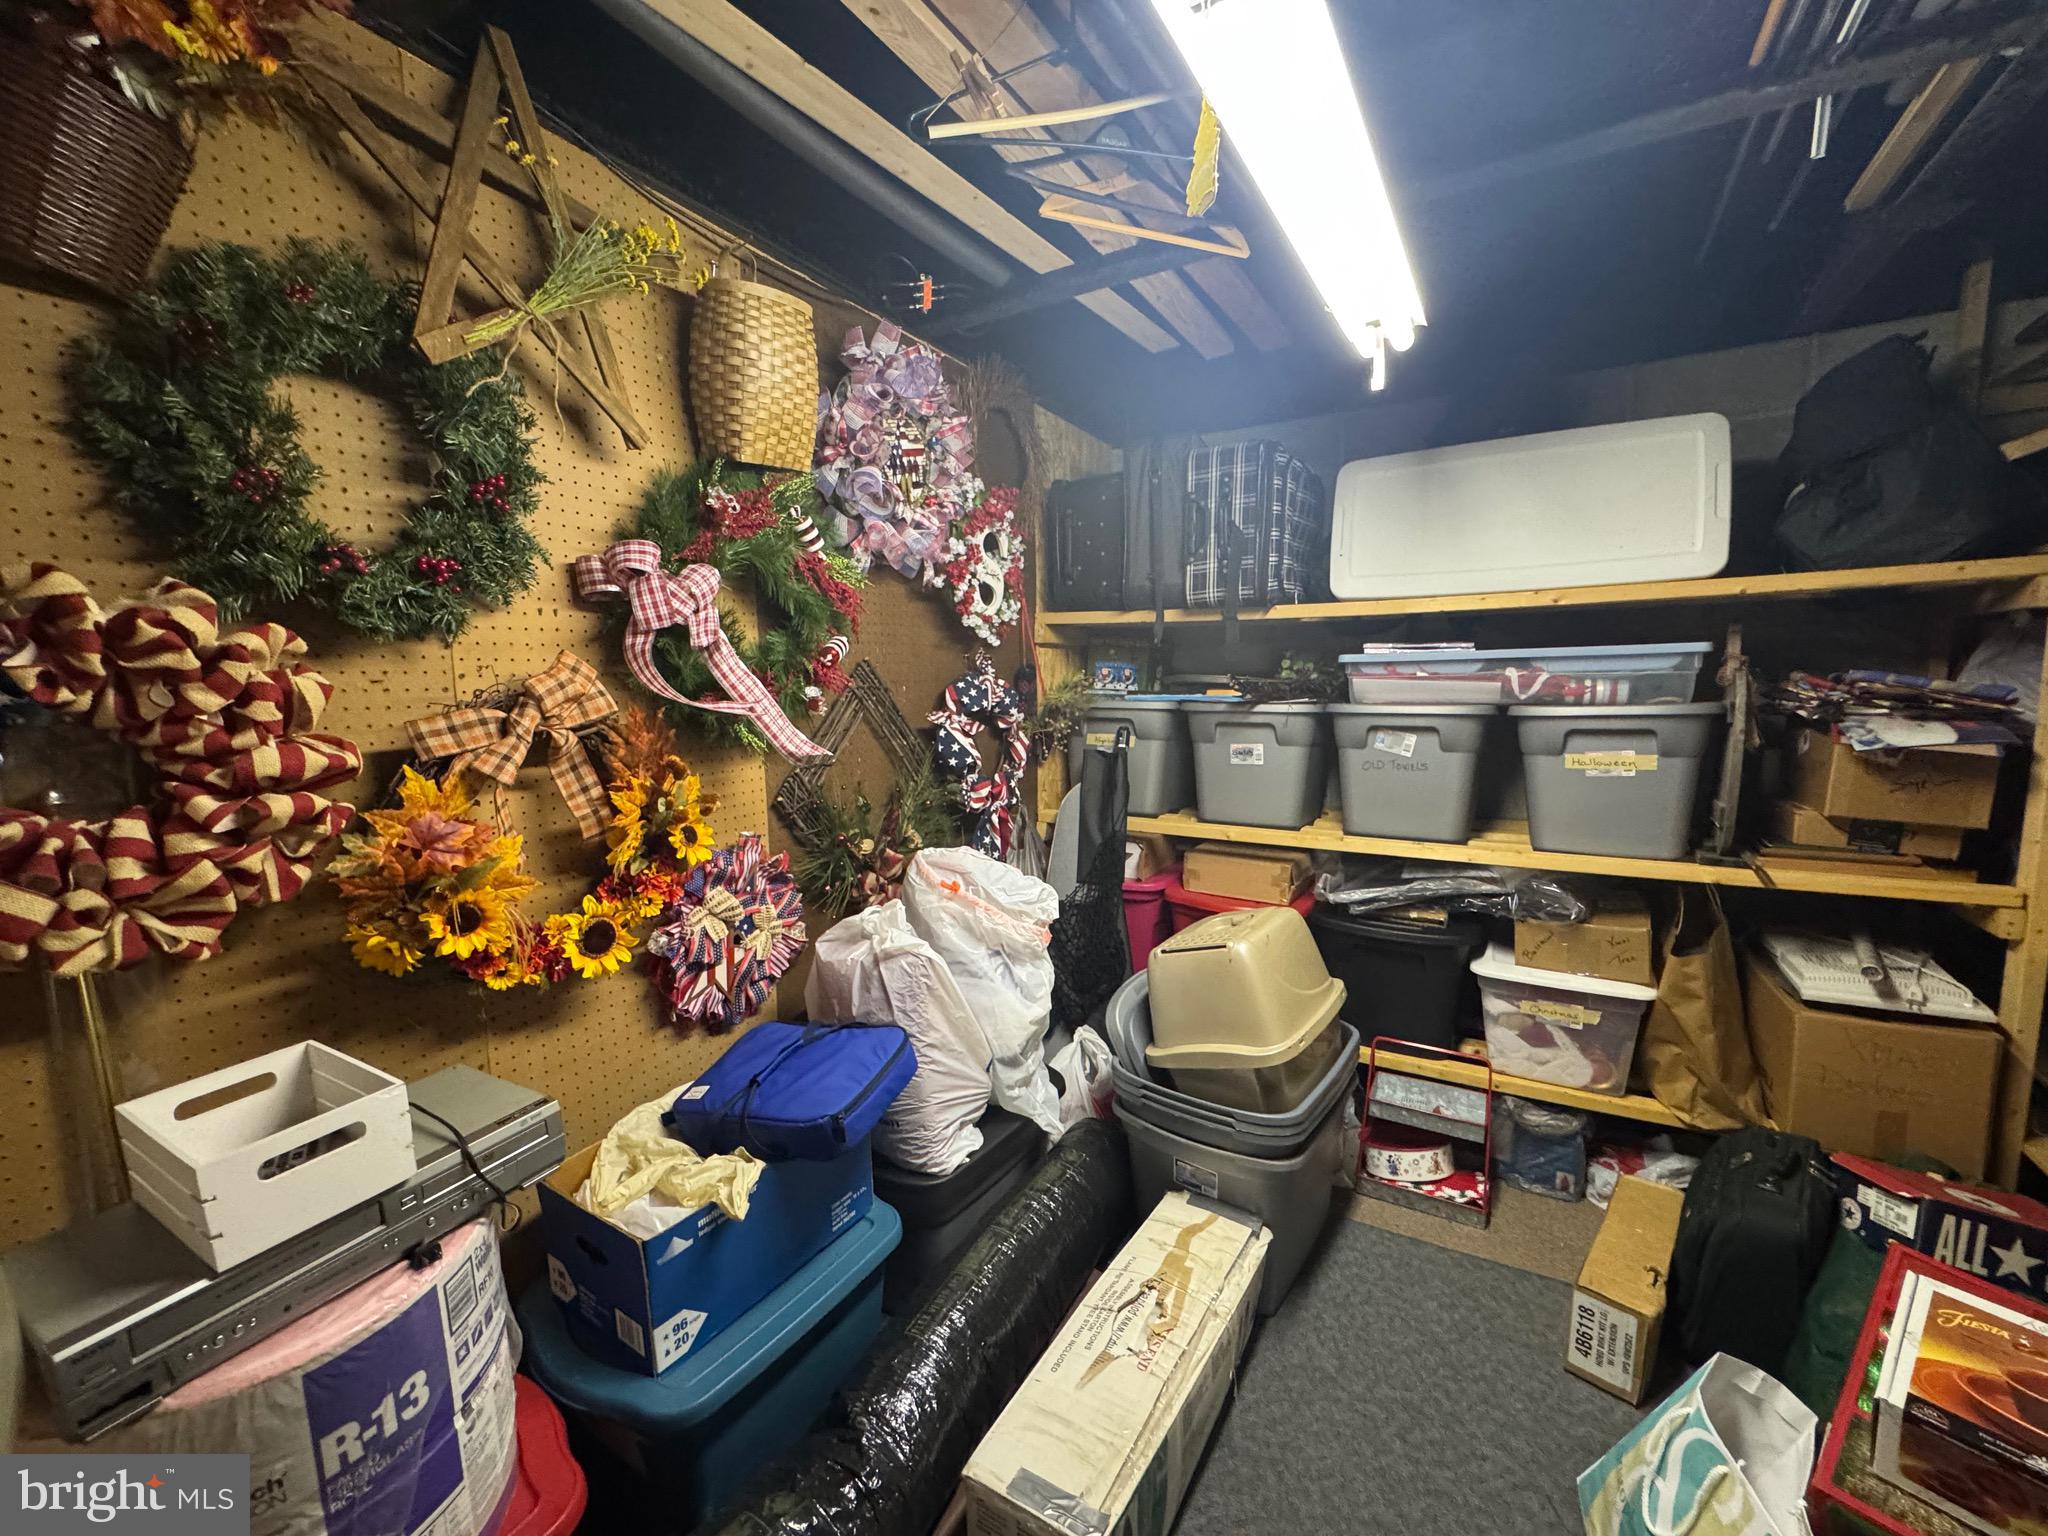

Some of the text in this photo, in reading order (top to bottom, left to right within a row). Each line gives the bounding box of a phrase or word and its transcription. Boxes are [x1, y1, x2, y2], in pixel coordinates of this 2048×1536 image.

[1361, 760, 1386, 771] OLD
[1572, 757, 1637, 769] Halloween
[1933, 1213, 1990, 1277] ALL
[672, 1317, 689, 1336] 96
[1574, 1304, 1595, 1359] 4B6118
[673, 1331, 690, 1352] 20
[1050, 1340, 1076, 1373] INCLUDED
[319, 1369, 431, 1480] R-13
